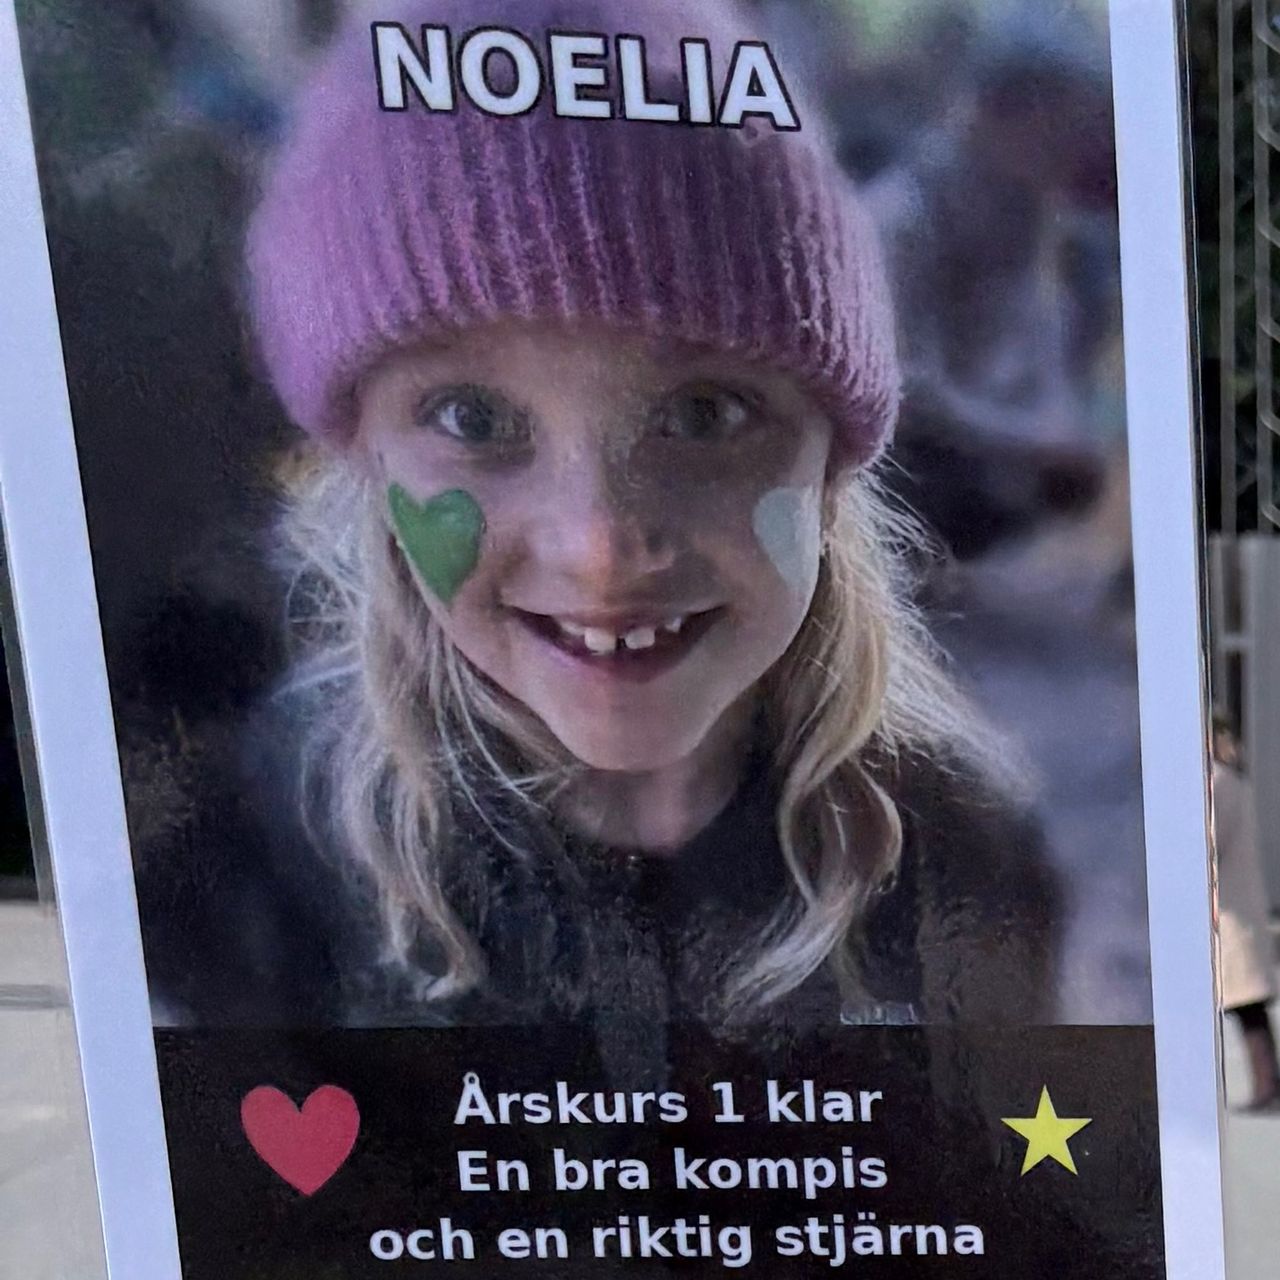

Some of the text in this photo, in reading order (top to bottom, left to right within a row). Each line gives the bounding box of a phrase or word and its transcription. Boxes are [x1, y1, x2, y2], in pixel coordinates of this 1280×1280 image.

[373, 23, 799, 129] NOELIA
[453, 1071, 883, 1125] Årskurs 1 klar
[457, 1146, 888, 1200] En bra kompis
[369, 1212, 985, 1268] och en riktig stjärna
